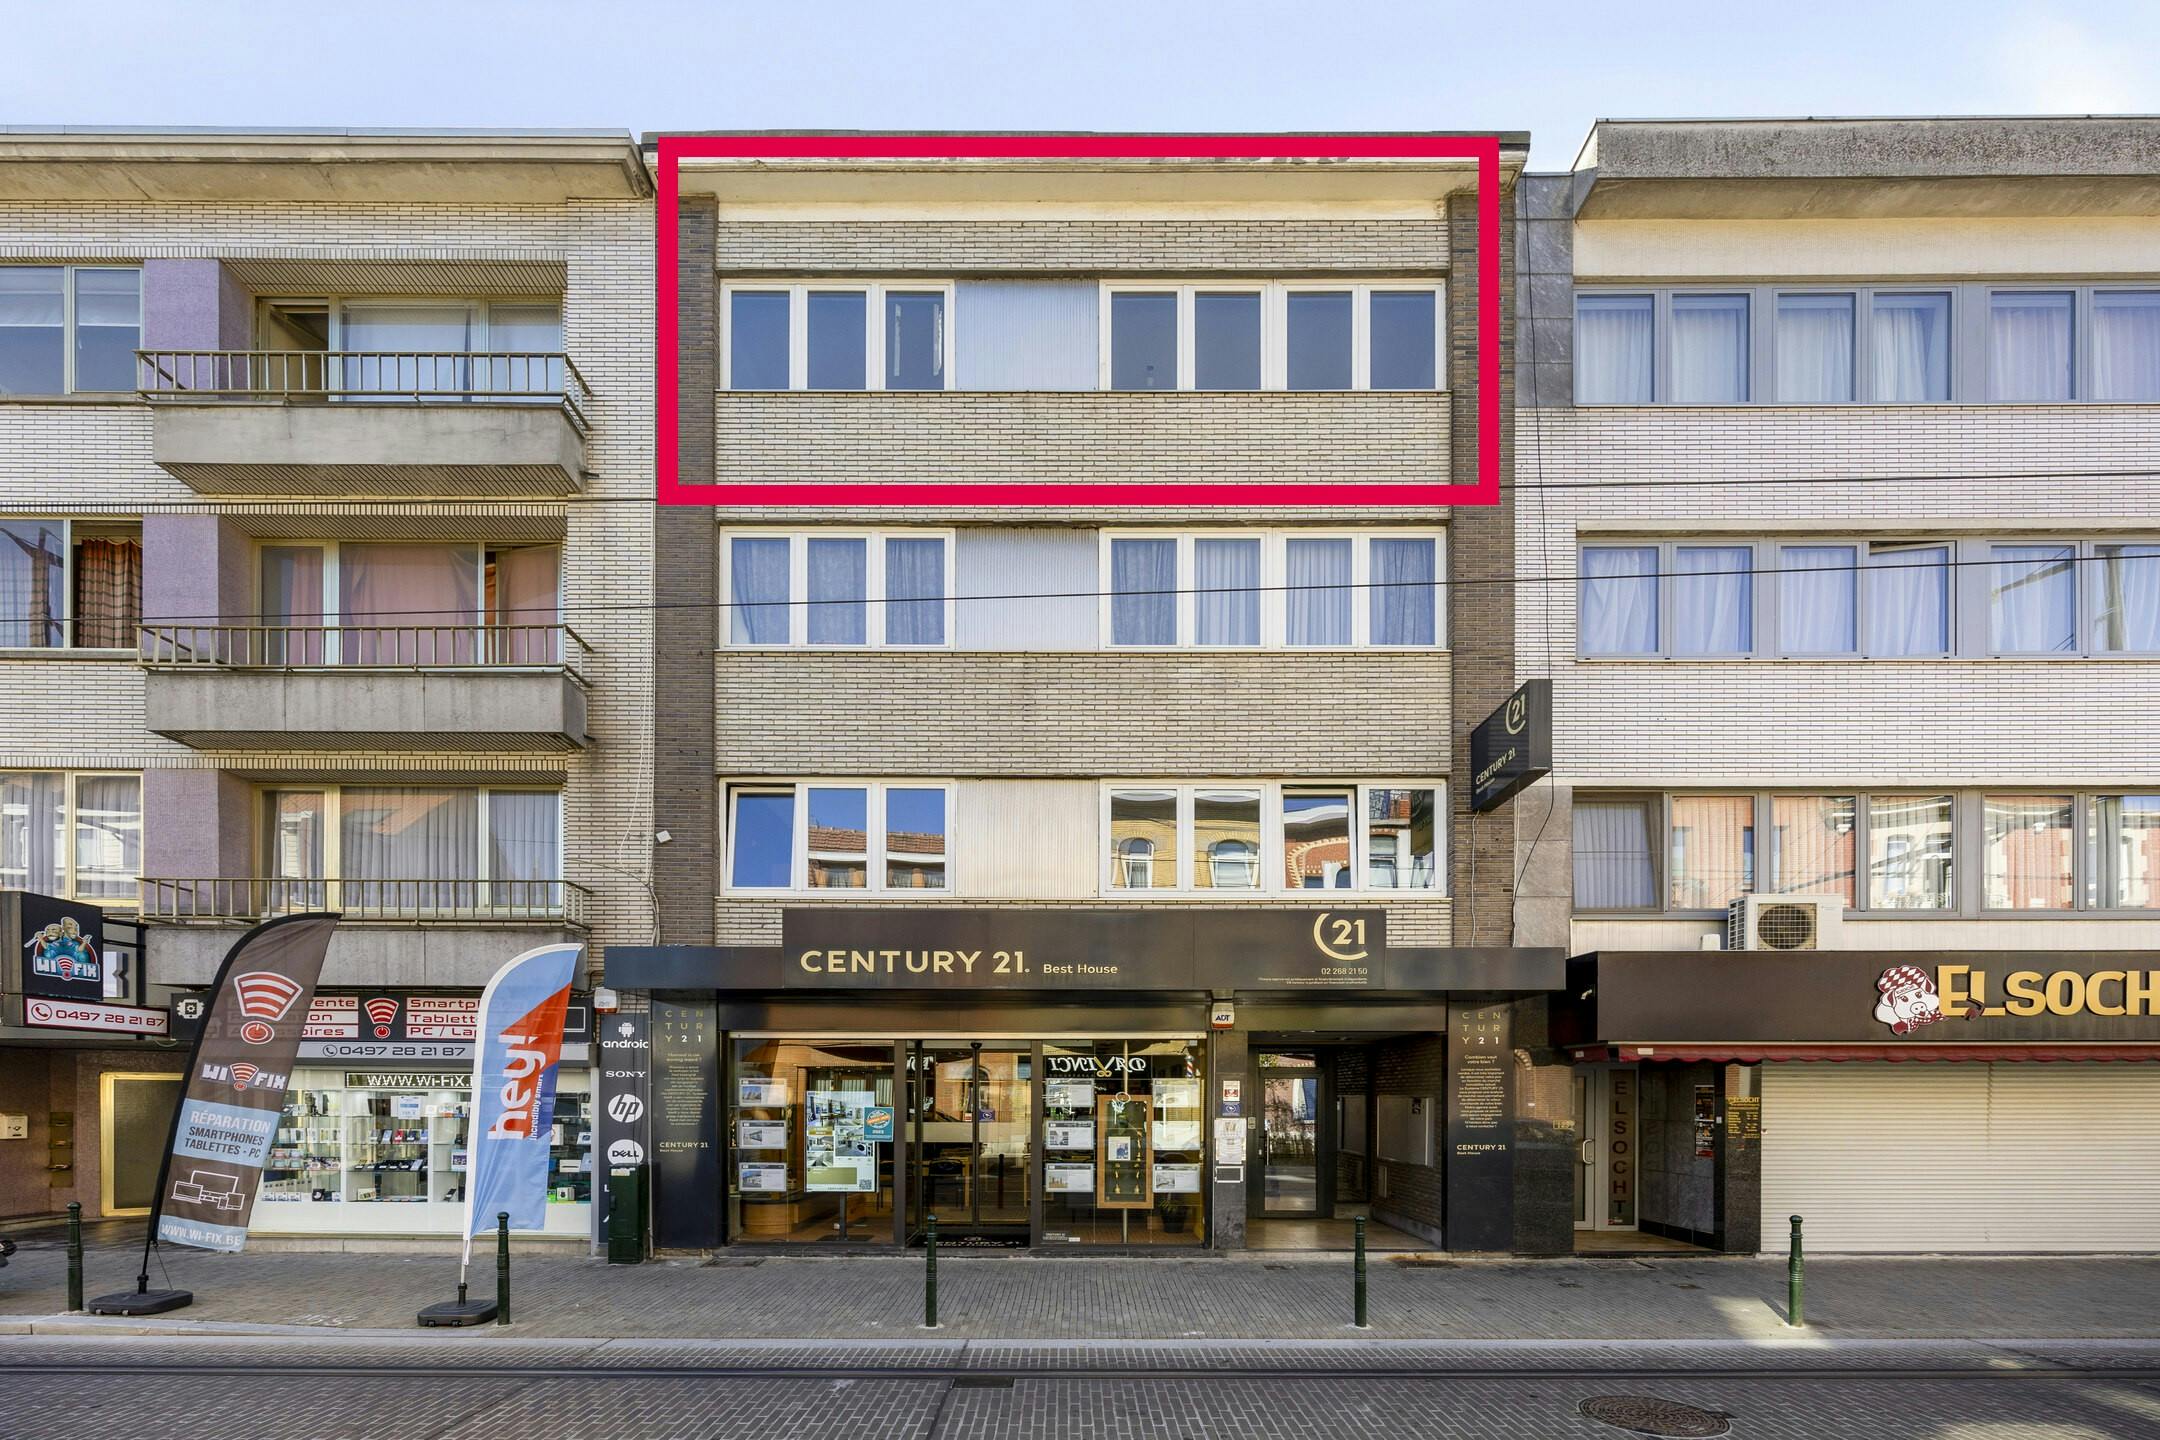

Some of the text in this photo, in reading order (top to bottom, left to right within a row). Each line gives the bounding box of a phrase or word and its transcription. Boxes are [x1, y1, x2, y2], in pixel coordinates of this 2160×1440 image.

[1475, 753, 1507, 785] CENTURY
[800, 951, 982, 973] CENTURY
[1043, 963, 1118, 974] Best House
[313, 998, 356, 1007] ente
[55, 1009, 165, 1027] 0497 28 21 87
[410, 1013, 478, 1023] Tablett
[1215, 1014, 1231, 1022] ADT
[410, 1027, 433, 1036] PC
[339, 1046, 466, 1056] 0497 28 21 87
[605, 1070, 647, 1078] SONY
[487, 1034, 547, 1140] hey!
[612, 1093, 640, 1123] hp
[190, 1110, 271, 1134] RÉPARATION
[188, 1126, 265, 1146] SMARTPHONES
[184, 1137, 241, 1155] TABLETTES
[248, 1147, 262, 1158] PC
[611, 1150, 640, 1158] DELL
[161, 1223, 241, 1246] WWW.WI-FIX.BE
